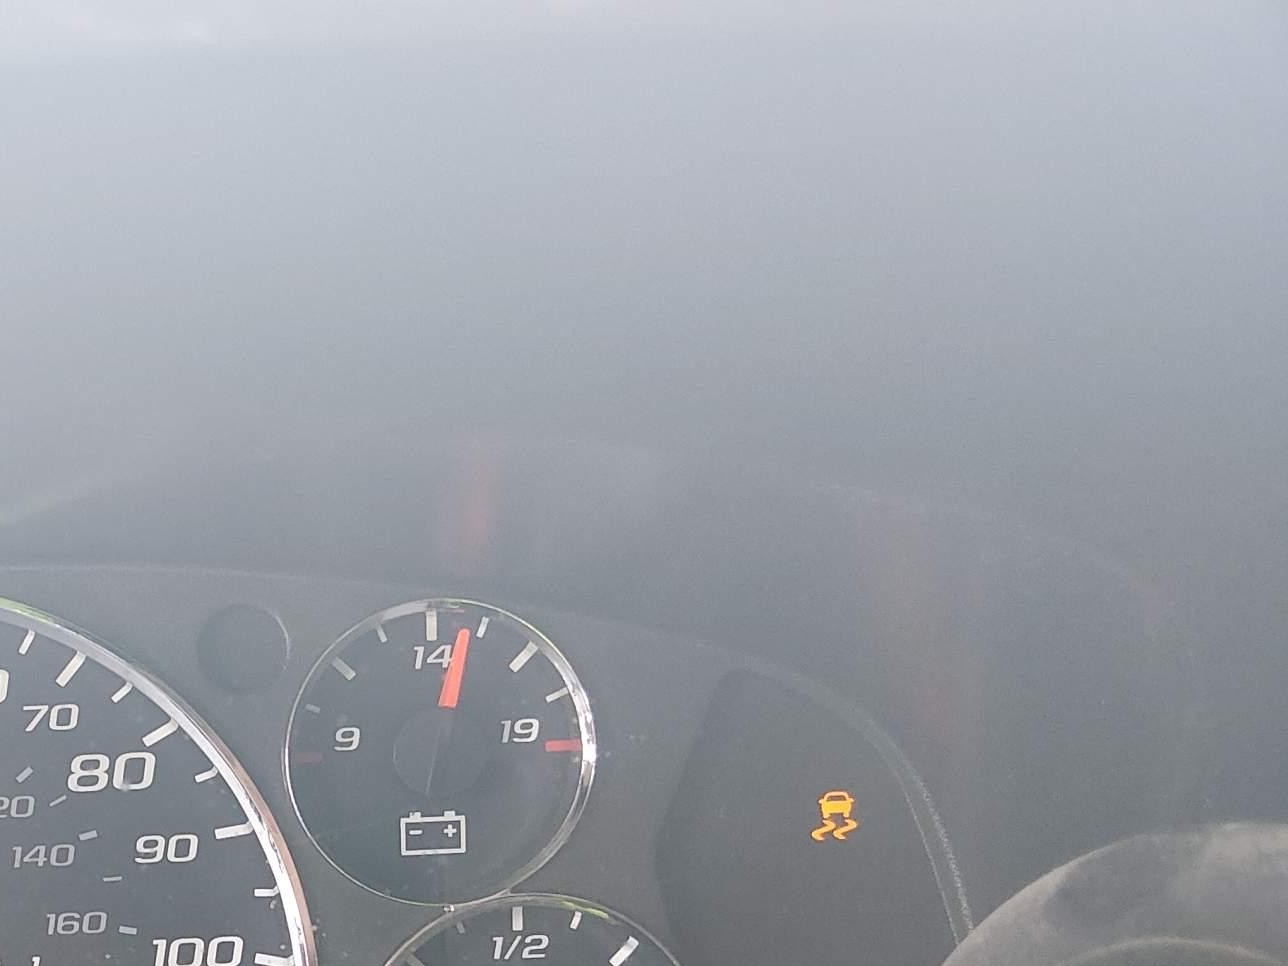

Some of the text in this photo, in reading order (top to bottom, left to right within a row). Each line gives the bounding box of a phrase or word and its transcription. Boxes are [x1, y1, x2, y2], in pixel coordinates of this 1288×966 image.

[413, 645, 452, 669] 14
[23, 704, 79, 731] 70
[335, 727, 360, 751] 9
[500, 719, 539, 744] 19
[67, 752, 156, 792] 80
[12, 844, 75, 868] 140
[134, 835, 198, 863] 90
[46, 911, 107, 935] 160
[492, 934, 550, 960] 1/2
